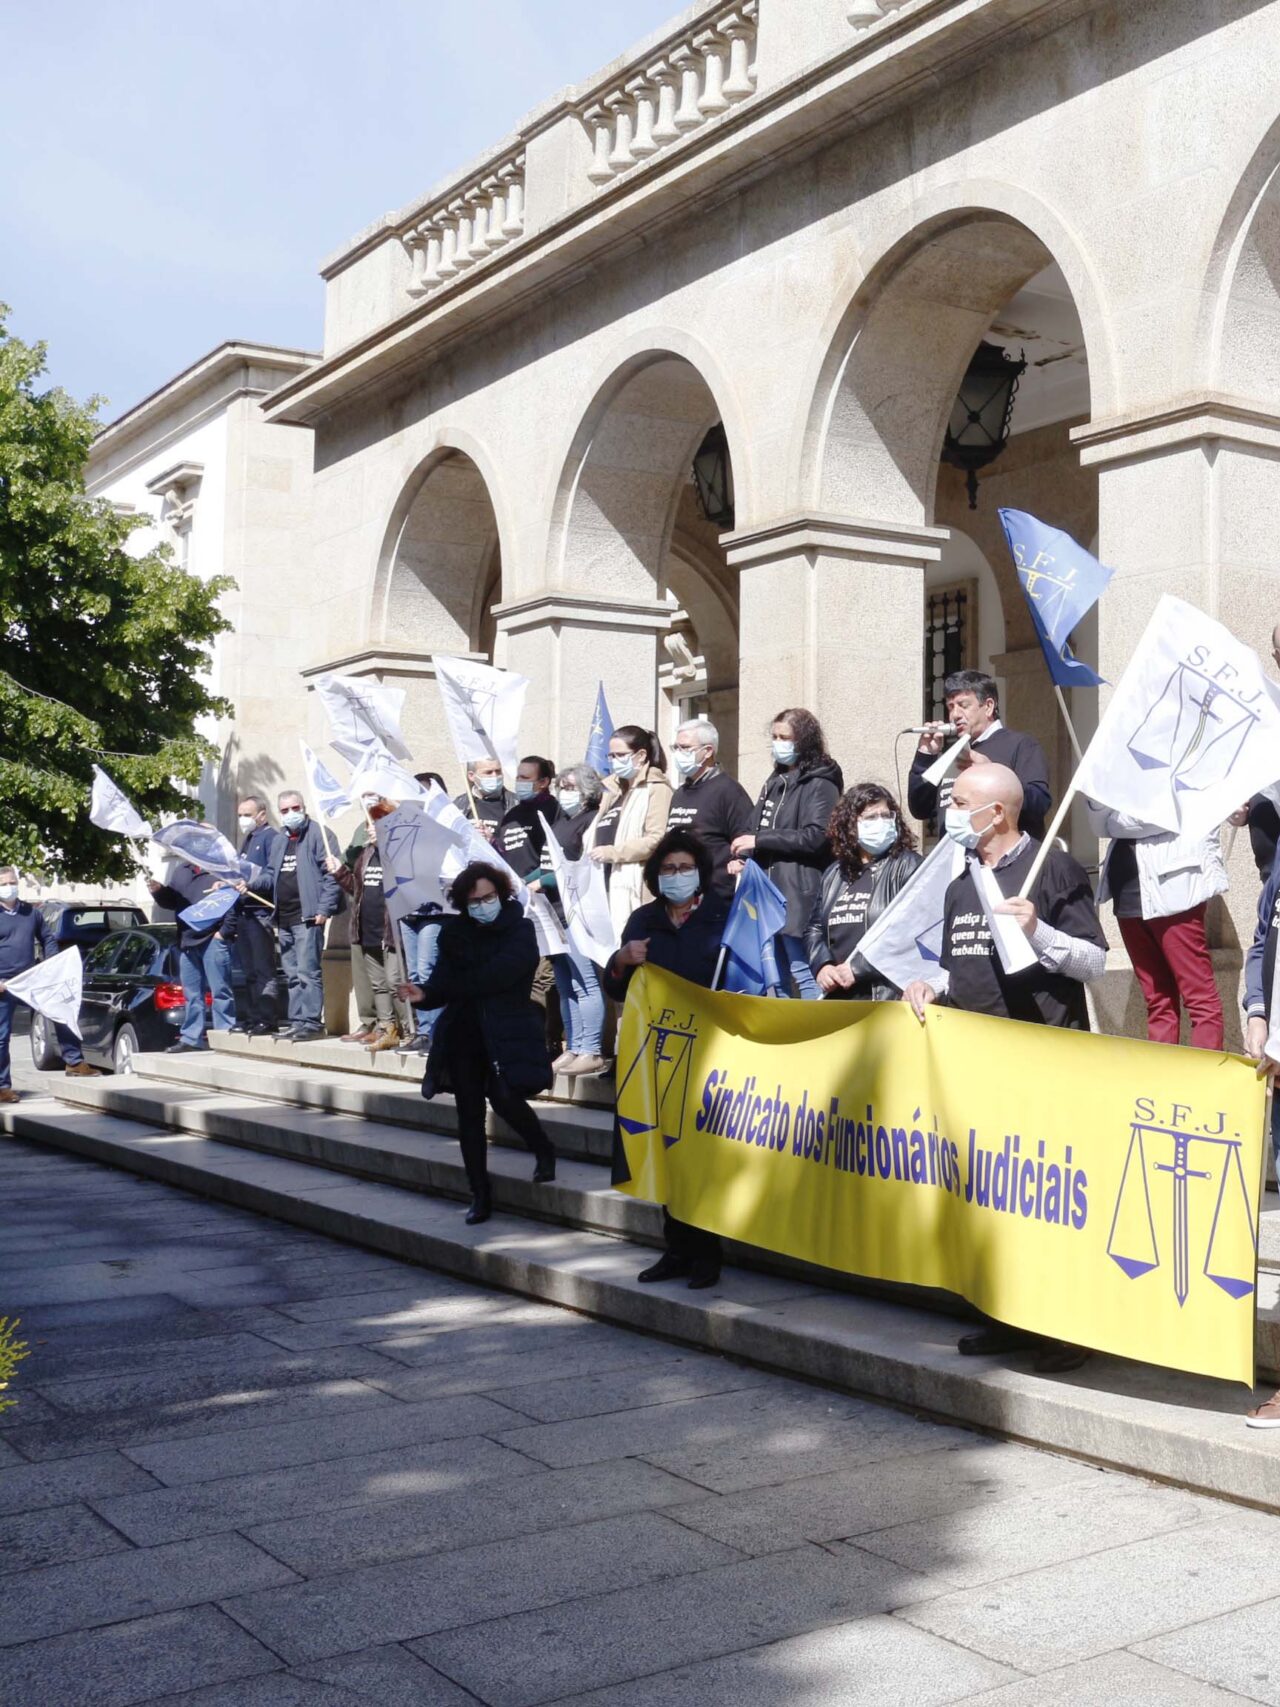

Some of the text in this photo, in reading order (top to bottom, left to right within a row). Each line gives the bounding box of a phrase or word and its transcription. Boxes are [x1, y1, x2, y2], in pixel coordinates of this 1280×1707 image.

[1013, 543, 1079, 587] S.F.J.
[1186, 645, 1265, 714] S.F.J.
[828, 913, 864, 926] rabalha!
[951, 931, 975, 945] quem
[951, 943, 995, 957] trabalha!
[1134, 1097, 1240, 1137] S.F.J.
[696, 1069, 1088, 1231] Sindicato dos Funcionários Judiciais
